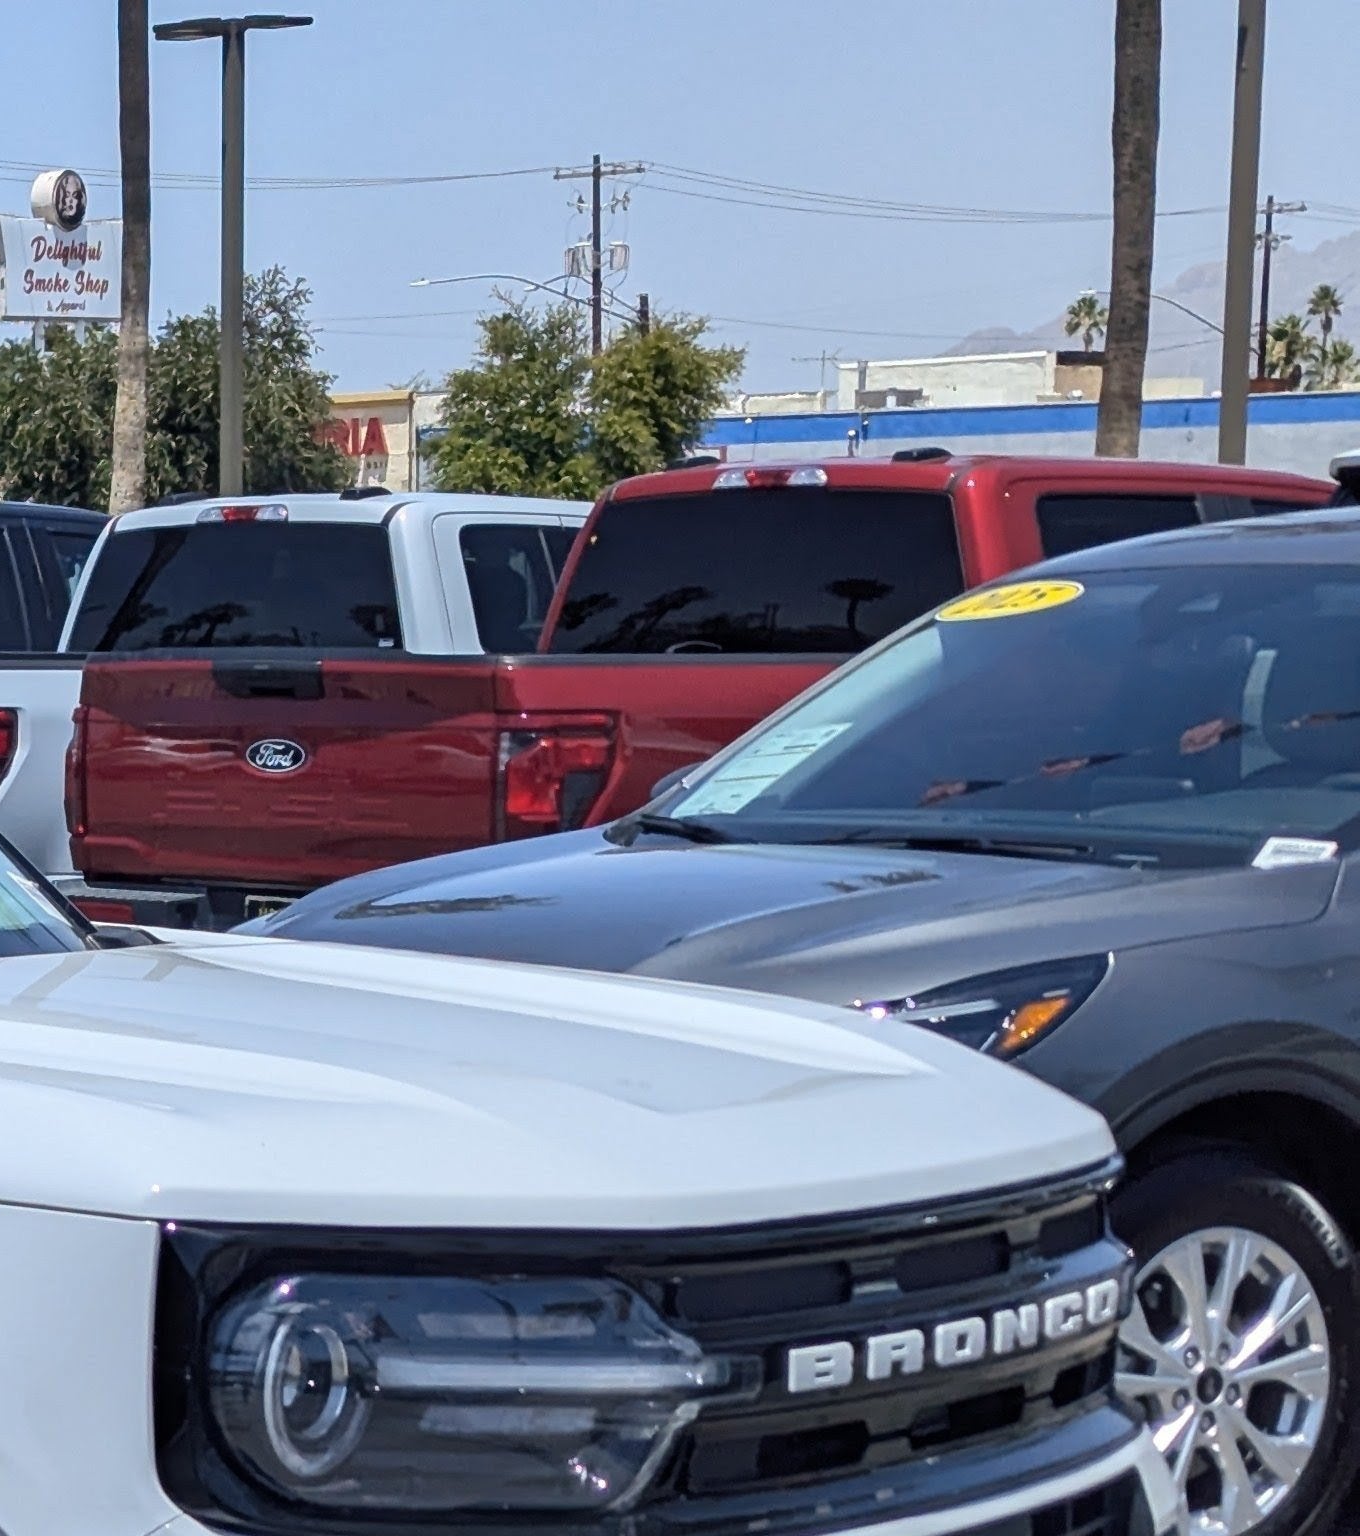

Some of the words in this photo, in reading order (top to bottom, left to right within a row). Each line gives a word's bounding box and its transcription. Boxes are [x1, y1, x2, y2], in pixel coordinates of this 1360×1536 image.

[30, 235, 103, 267] Delightful
[23, 269, 70, 294] Smoke
[74, 270, 109, 299] Shop
[256, 743, 295, 767] Ford
[787, 1278, 1120, 1394] BRONCO
